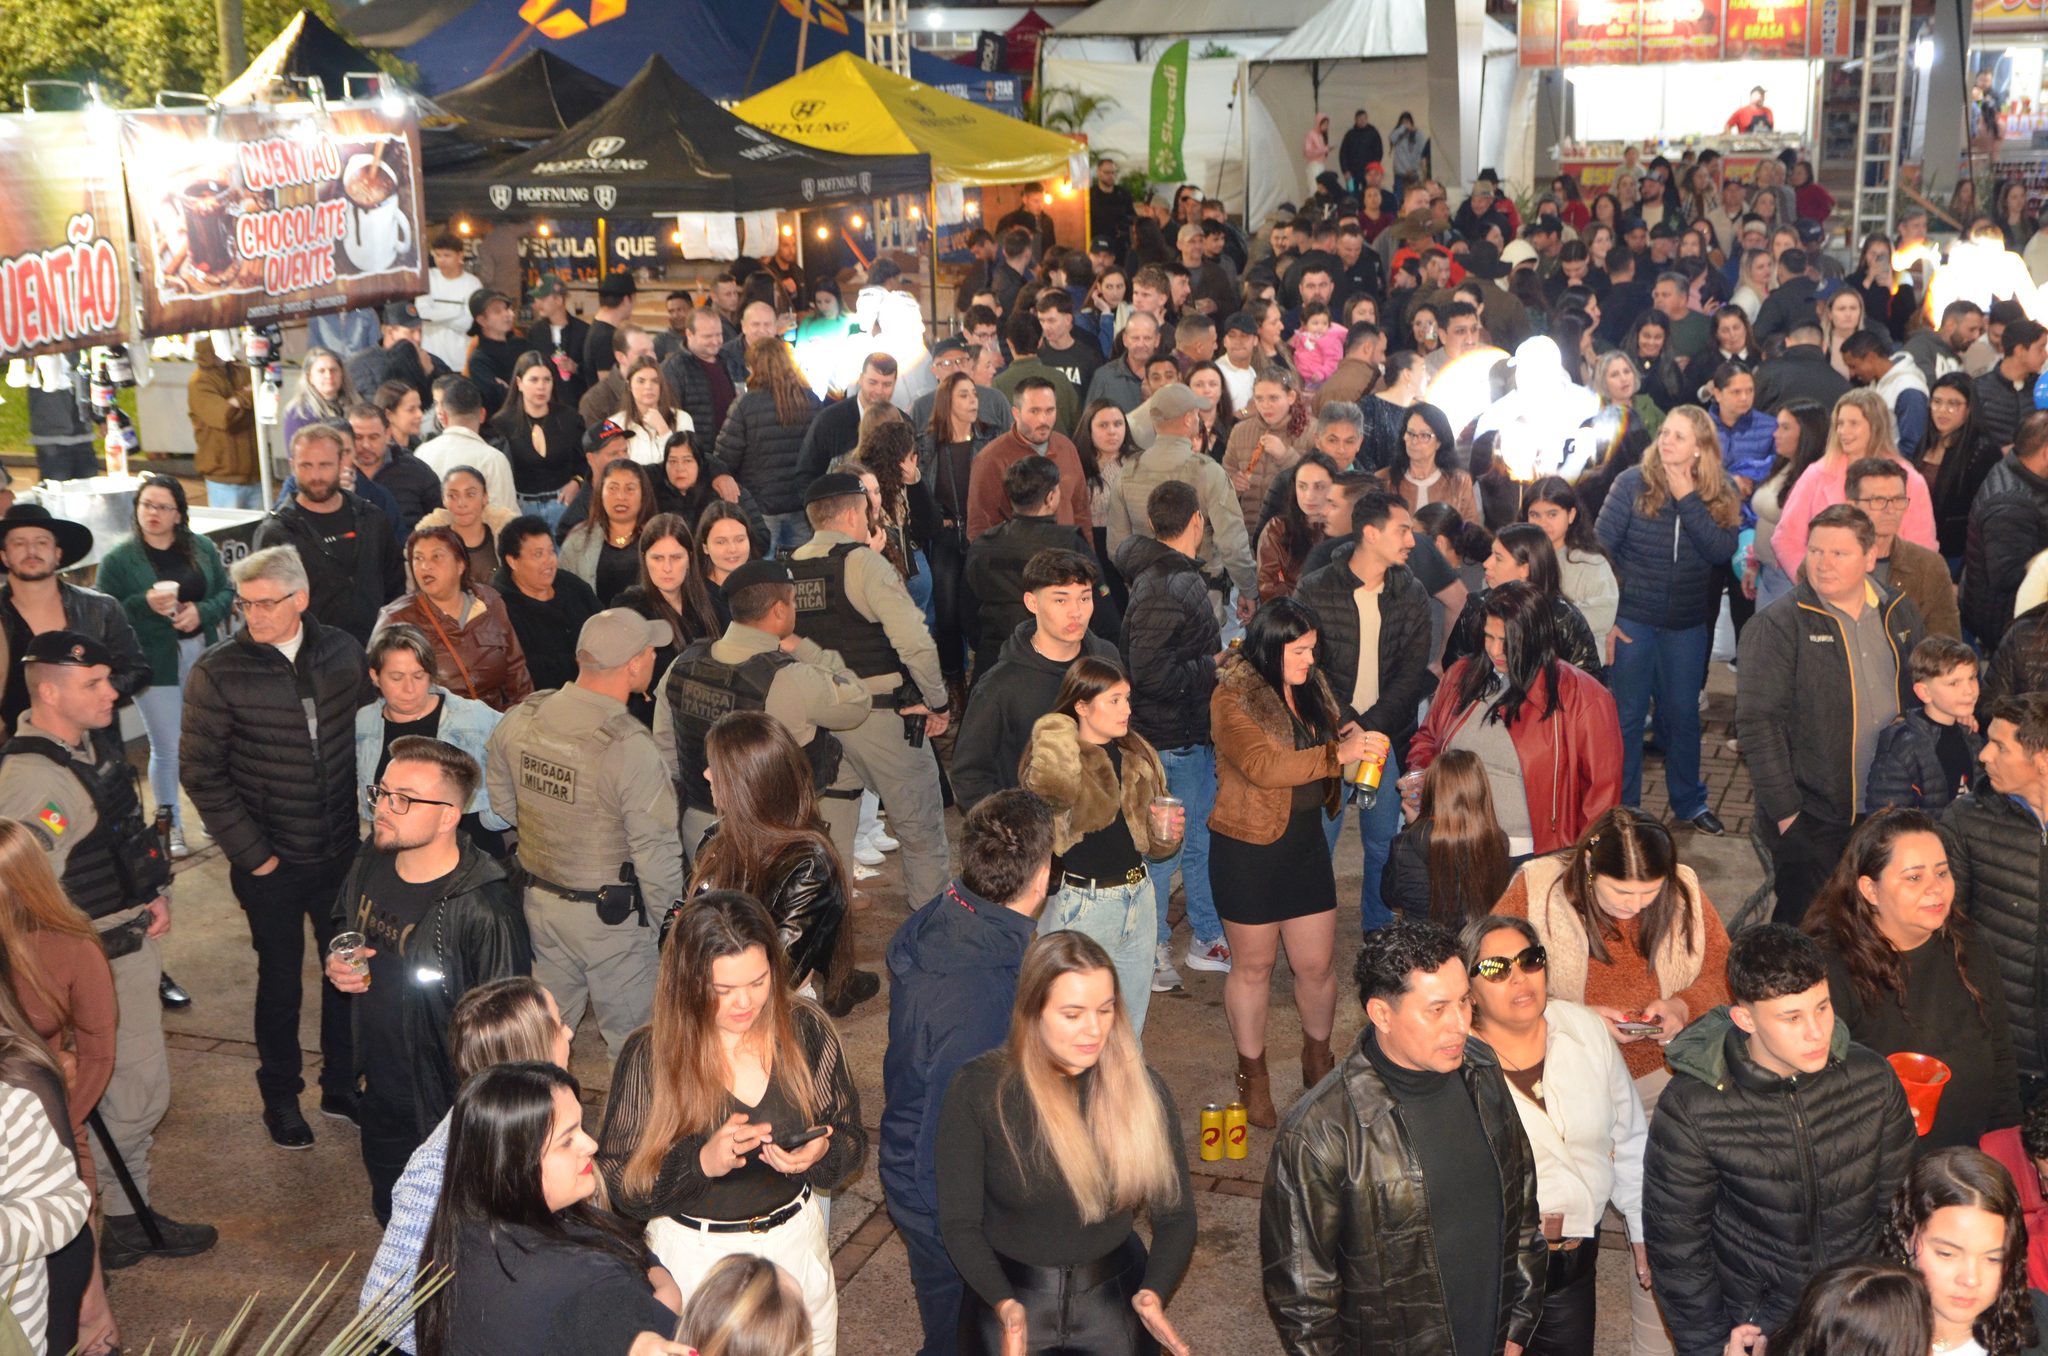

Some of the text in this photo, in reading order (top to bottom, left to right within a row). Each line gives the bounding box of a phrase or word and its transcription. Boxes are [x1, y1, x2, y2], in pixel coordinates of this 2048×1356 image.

[1744, 23, 1784, 39] BRASA
[516, 187, 589, 201] HOFFNUNG
[817, 175, 857, 192] HOFFNUNG
[238, 198, 346, 258] CHOCOLATE
[517, 235, 657, 260] VEICULA QUE
[265, 242, 335, 294] QUENTE
[0, 214, 118, 351] UENTÃO
[795, 582, 821, 598] RÇA
[795, 595, 824, 609] TICA
[523, 756, 572, 784] BRIGADA
[525, 773, 568, 800] MILITAR
[369, 916, 399, 940] BOSS
